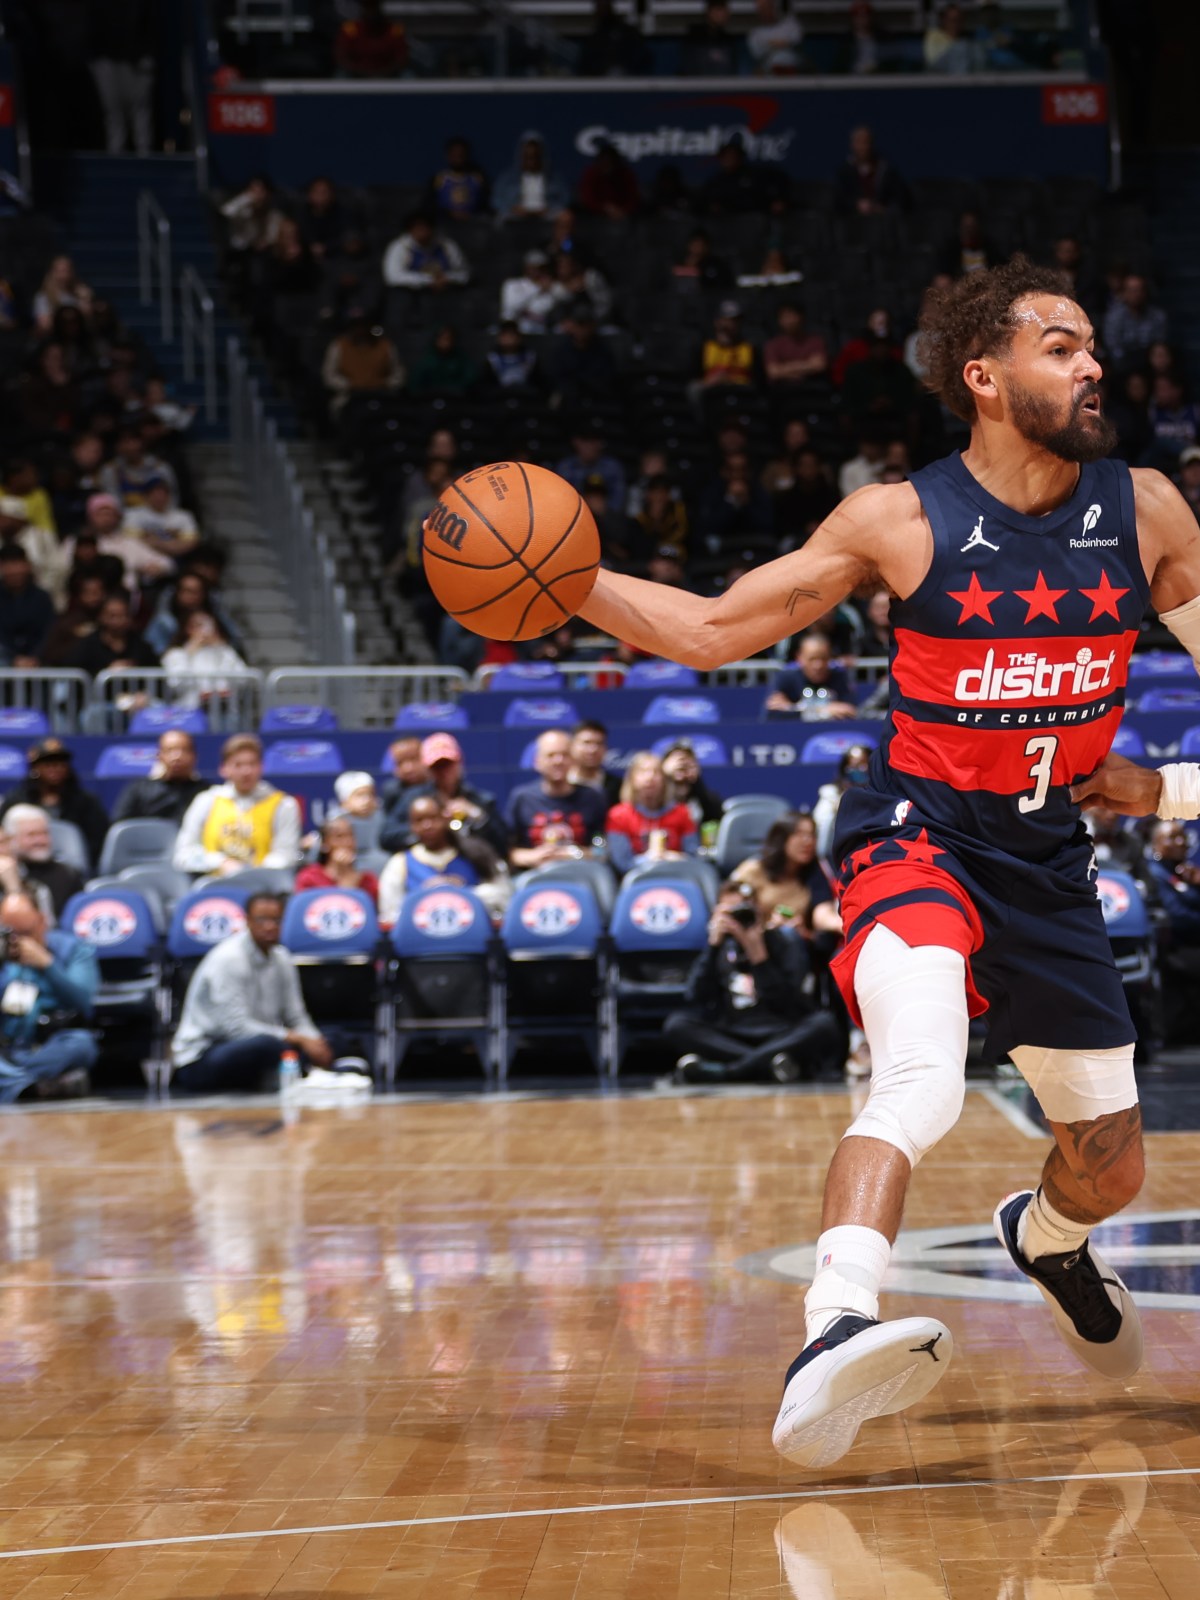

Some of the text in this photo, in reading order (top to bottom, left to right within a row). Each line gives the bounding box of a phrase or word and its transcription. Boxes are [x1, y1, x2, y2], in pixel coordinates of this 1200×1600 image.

[1052, 91, 1099, 117] 106
[1070, 536, 1119, 548] Robinhood
[1008, 652, 1037, 666] THE
[957, 703, 1106, 724] OF COLUMBIA
[1018, 735, 1059, 814] 3
